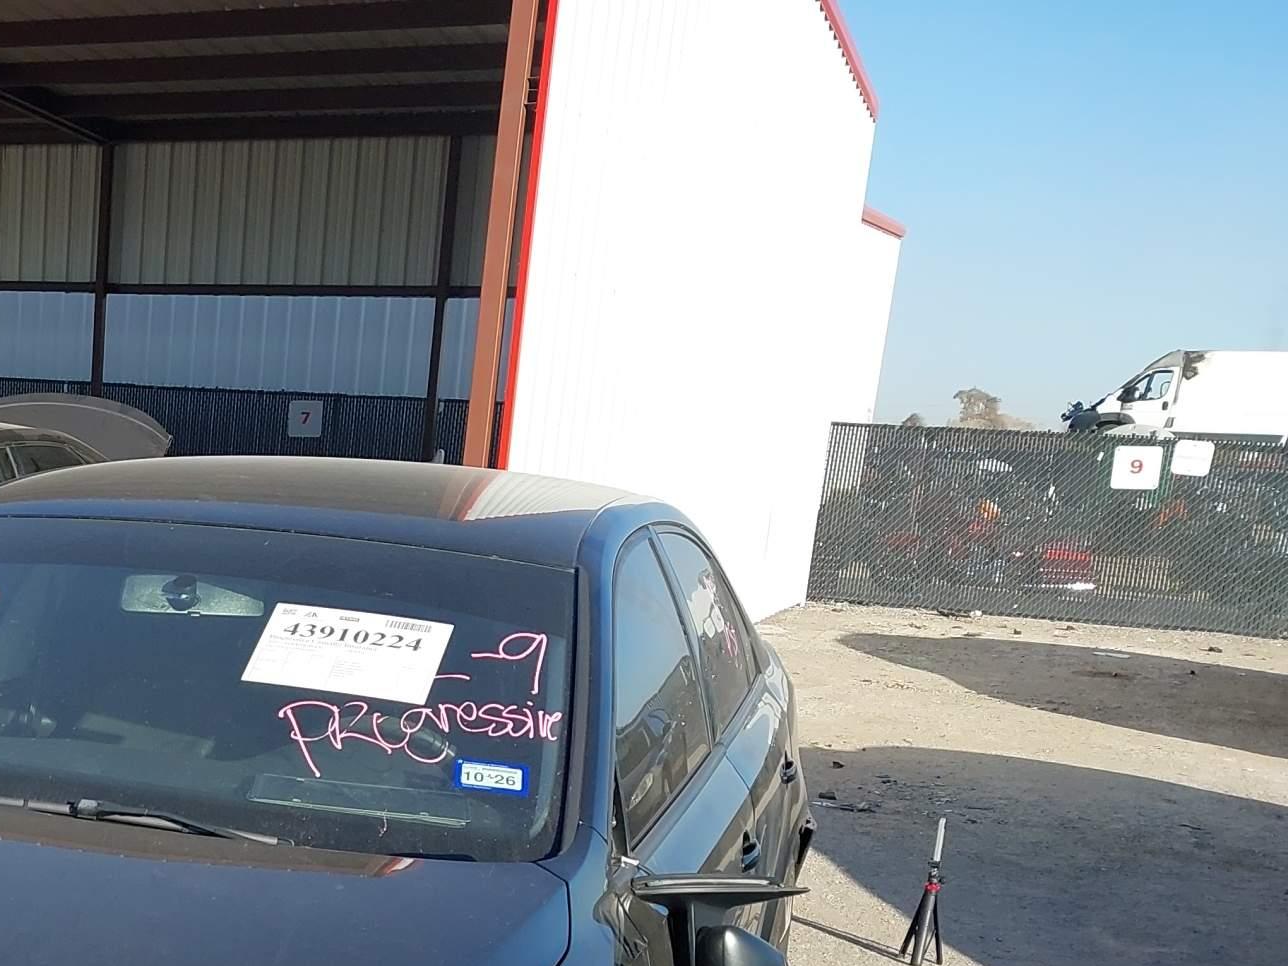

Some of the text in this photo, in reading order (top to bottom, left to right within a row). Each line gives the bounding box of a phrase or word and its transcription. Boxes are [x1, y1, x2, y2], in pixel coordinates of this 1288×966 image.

[301, 411, 312, 425] 7
[1129, 459, 1144, 474] 9
[283, 621, 423, 652] 43910224
[464, 771, 516, 786] 10 26
